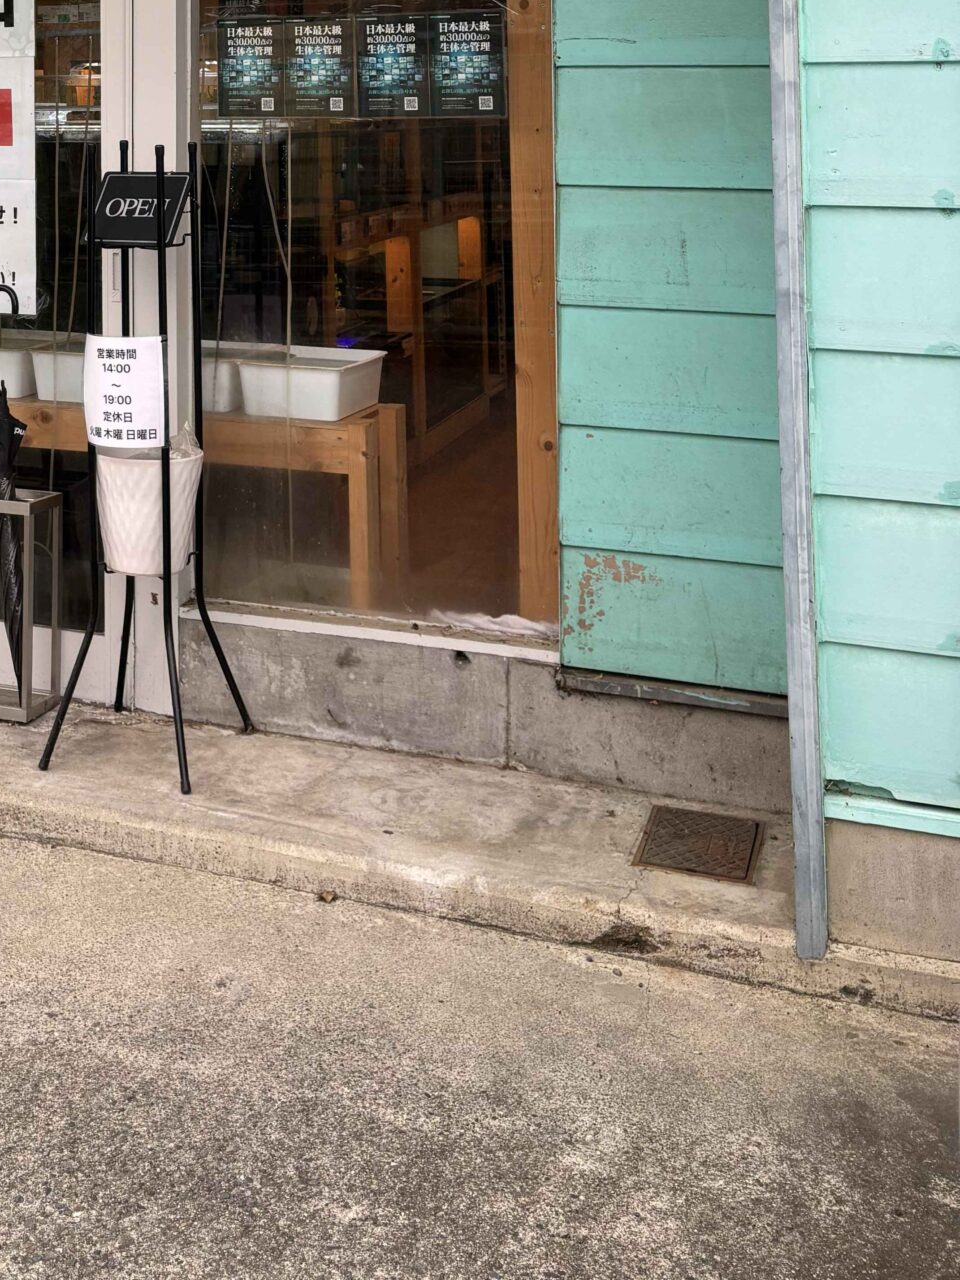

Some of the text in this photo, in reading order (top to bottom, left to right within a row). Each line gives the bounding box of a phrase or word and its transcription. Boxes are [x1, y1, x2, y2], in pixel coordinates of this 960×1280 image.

[227, 26, 273, 37] 日本最大級
[294, 25, 342, 36] 日本最大級
[366, 23, 416, 34] 日本最大級
[439, 21, 490, 32] 日本最大級
[228, 47, 273, 56] 生体を管理
[295, 45, 342, 55] 生体を管理
[367, 44, 416, 54] 生体を管理
[440, 42, 491, 52] 生体を管理
[97, 348, 137, 360] 営業時間
[102, 363, 131, 373] 14:00
[103, 394, 132, 405] 19:00
[103, 411, 133, 423] 定休日
[103, 428, 123, 440] 木曜
[126, 429, 157, 440] 日曜日
